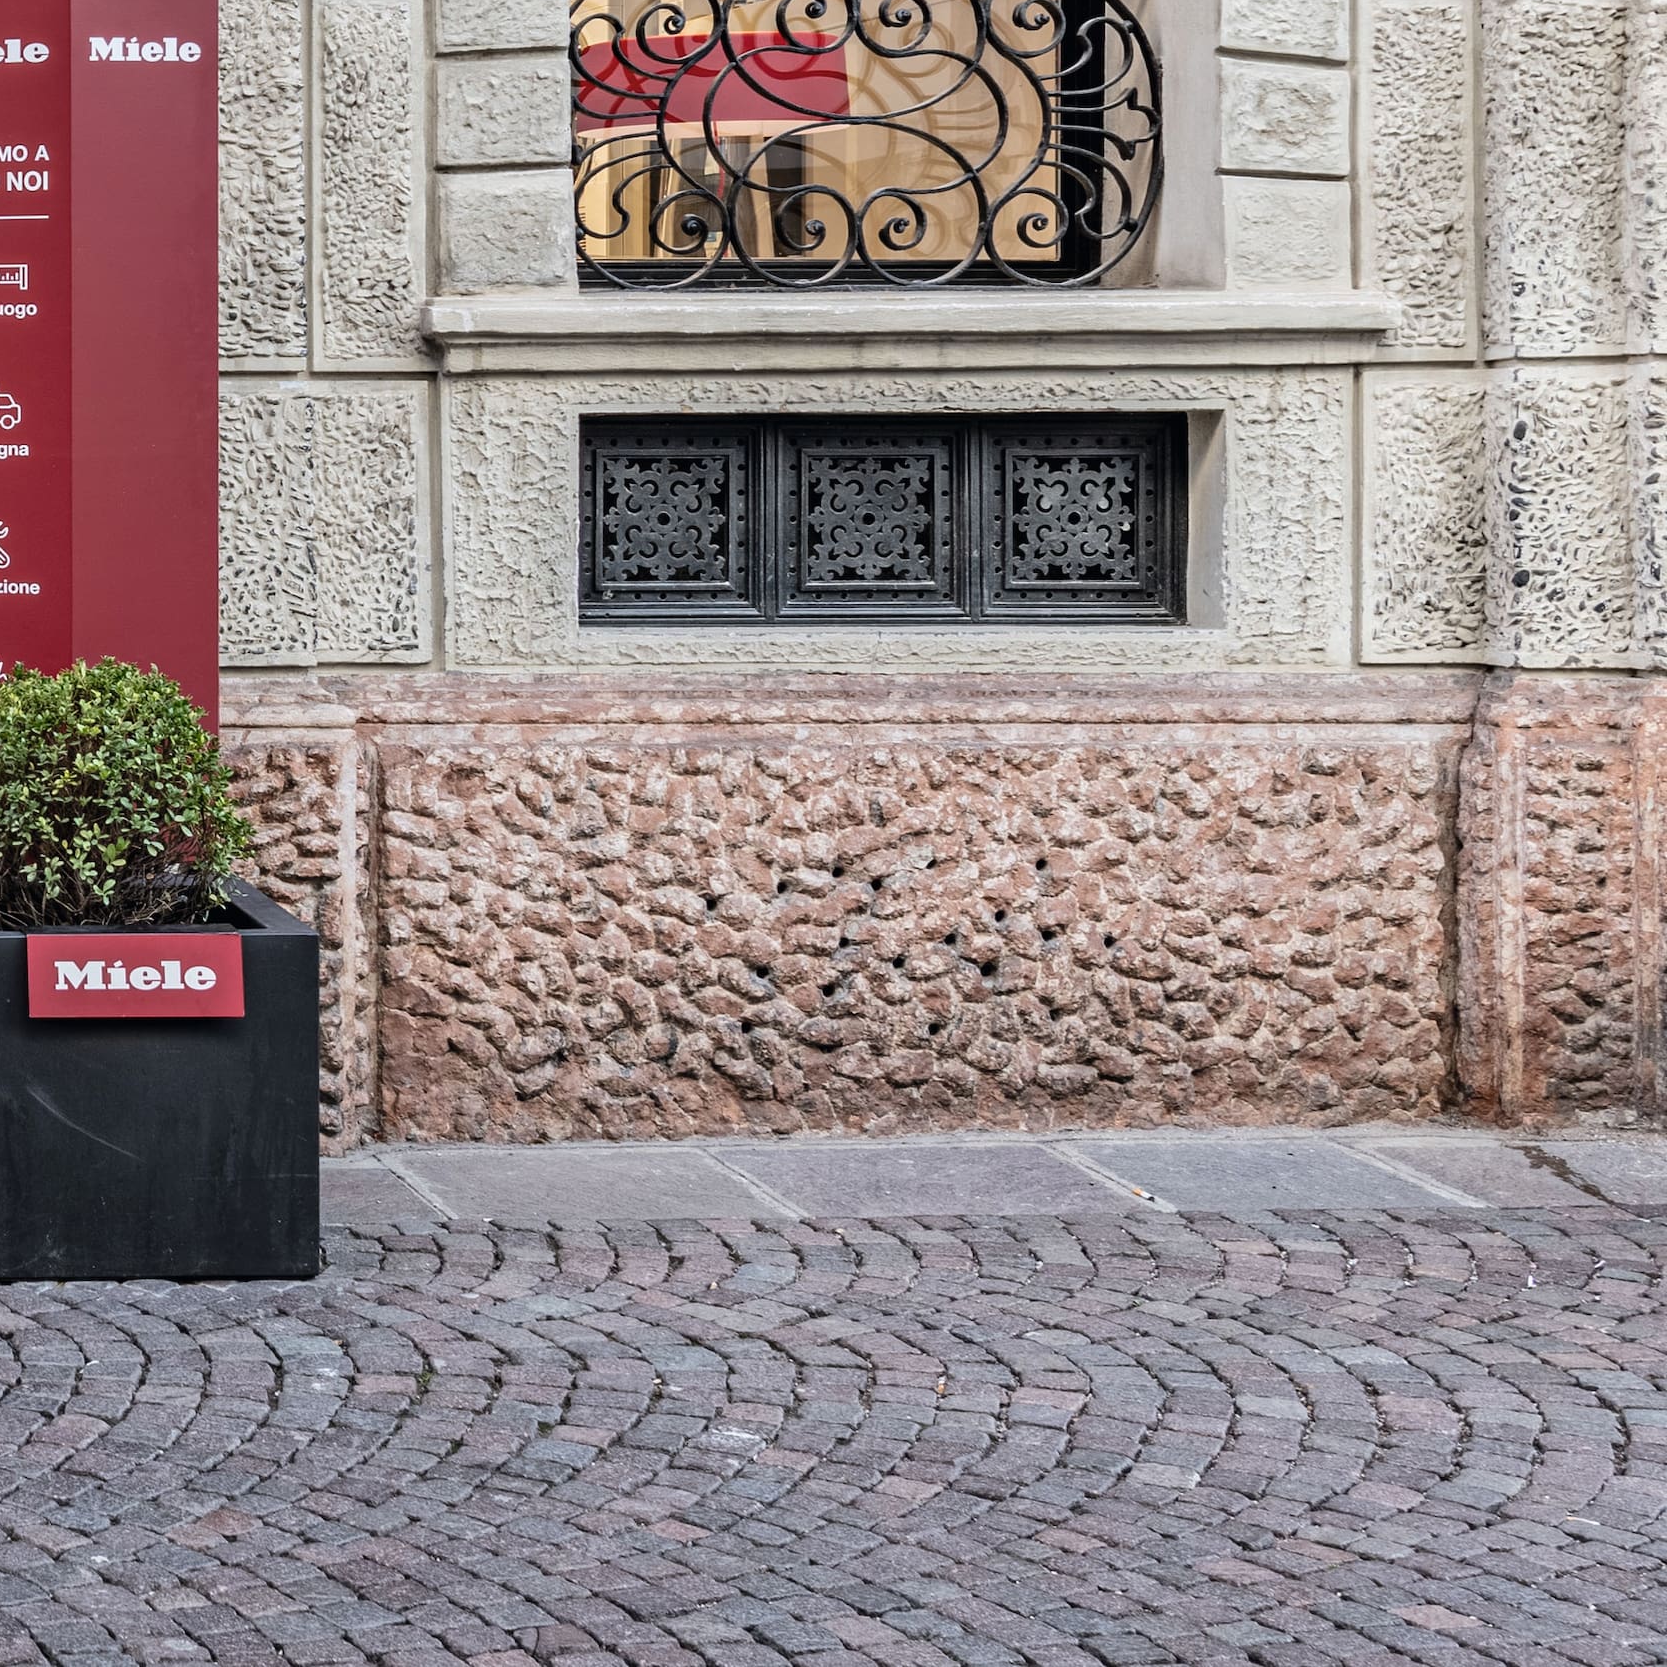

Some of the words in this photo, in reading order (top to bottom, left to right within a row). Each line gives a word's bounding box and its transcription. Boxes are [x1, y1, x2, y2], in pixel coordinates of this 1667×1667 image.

[89, 37, 201, 62] Miele
[35, 145, 49, 161] A
[7, 171, 48, 191] NOI
[55, 960, 216, 990] Miele
